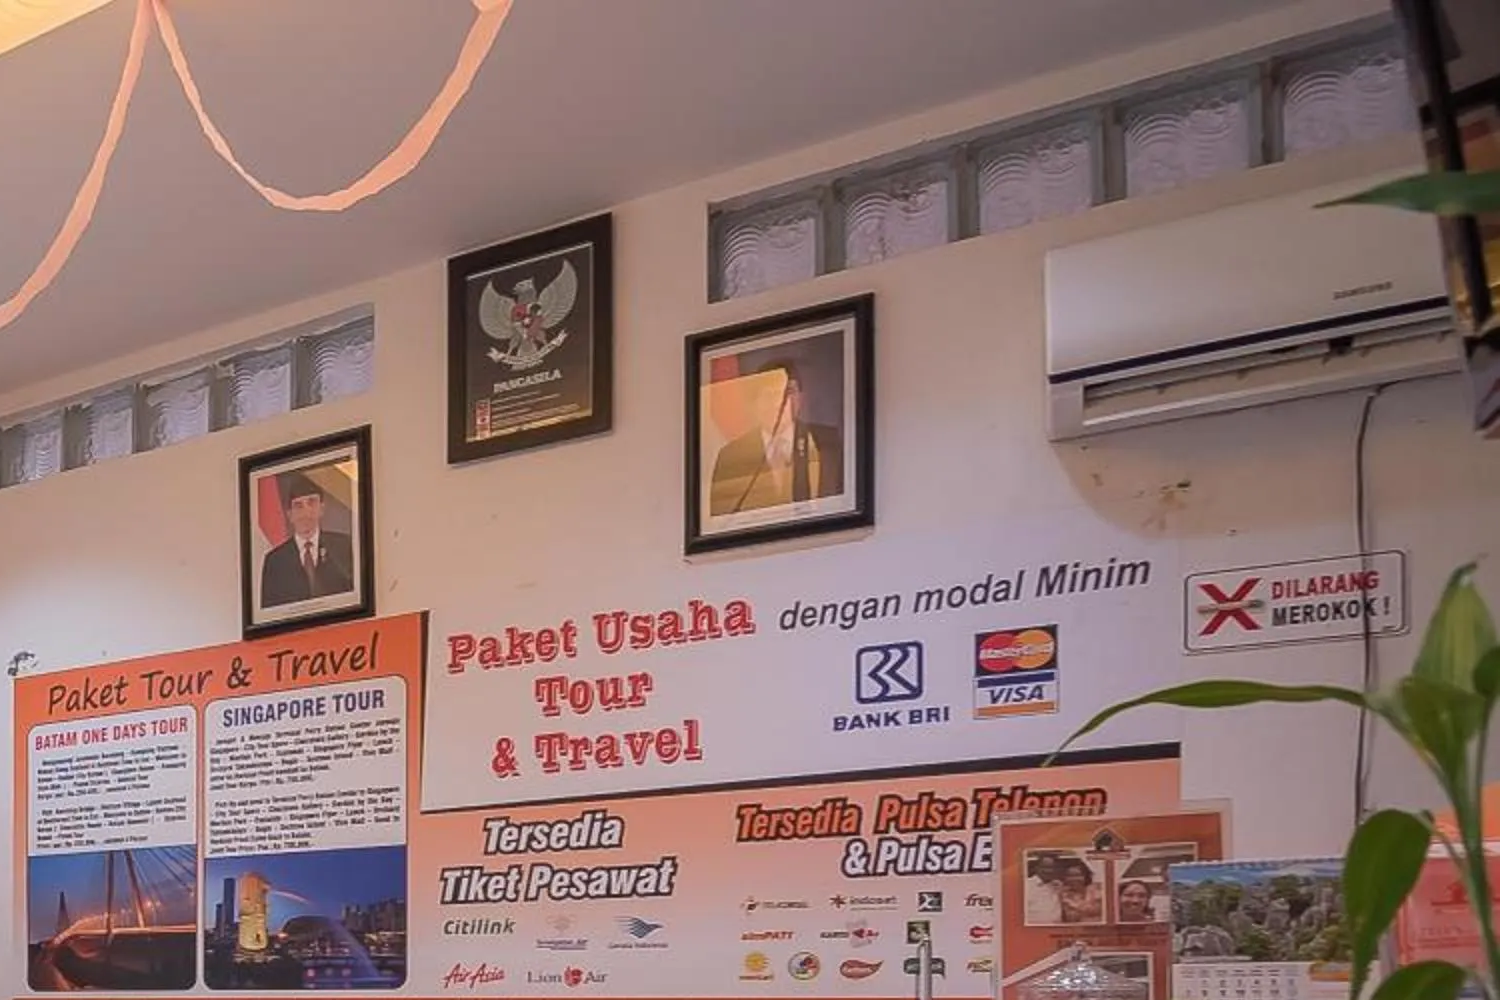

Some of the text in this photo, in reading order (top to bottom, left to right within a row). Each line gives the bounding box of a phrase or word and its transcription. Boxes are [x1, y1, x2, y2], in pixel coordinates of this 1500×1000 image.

[493, 369, 562, 393] PANCASILA
[778, 557, 1150, 632] dengan modal Minim
[1271, 570, 1379, 600] DILARANG
[1272, 598, 1377, 626] MEROKOK
[447, 598, 755, 673] Paket Usaha
[47, 632, 379, 714] Paket Tour & Travel
[534, 669, 652, 716] Tour
[223, 690, 384, 728] SINGAPORE TOUR
[989, 684, 1045, 704] VISA
[35, 717, 188, 751] BATAM ONE DAYS TOUR
[833, 706, 950, 731] BANK BRI
[491, 720, 703, 778] & Travel
[484, 810, 624, 855] Tersedia
[737, 798, 861, 843] Tersedia
[873, 791, 967, 834] Pulsa
[841, 840, 872, 877] &
[872, 835, 965, 875] Pulsa
[441, 857, 677, 904] Tiket Pesawat
[443, 917, 516, 937] Citilink
[527, 969, 608, 985] Lion Air
